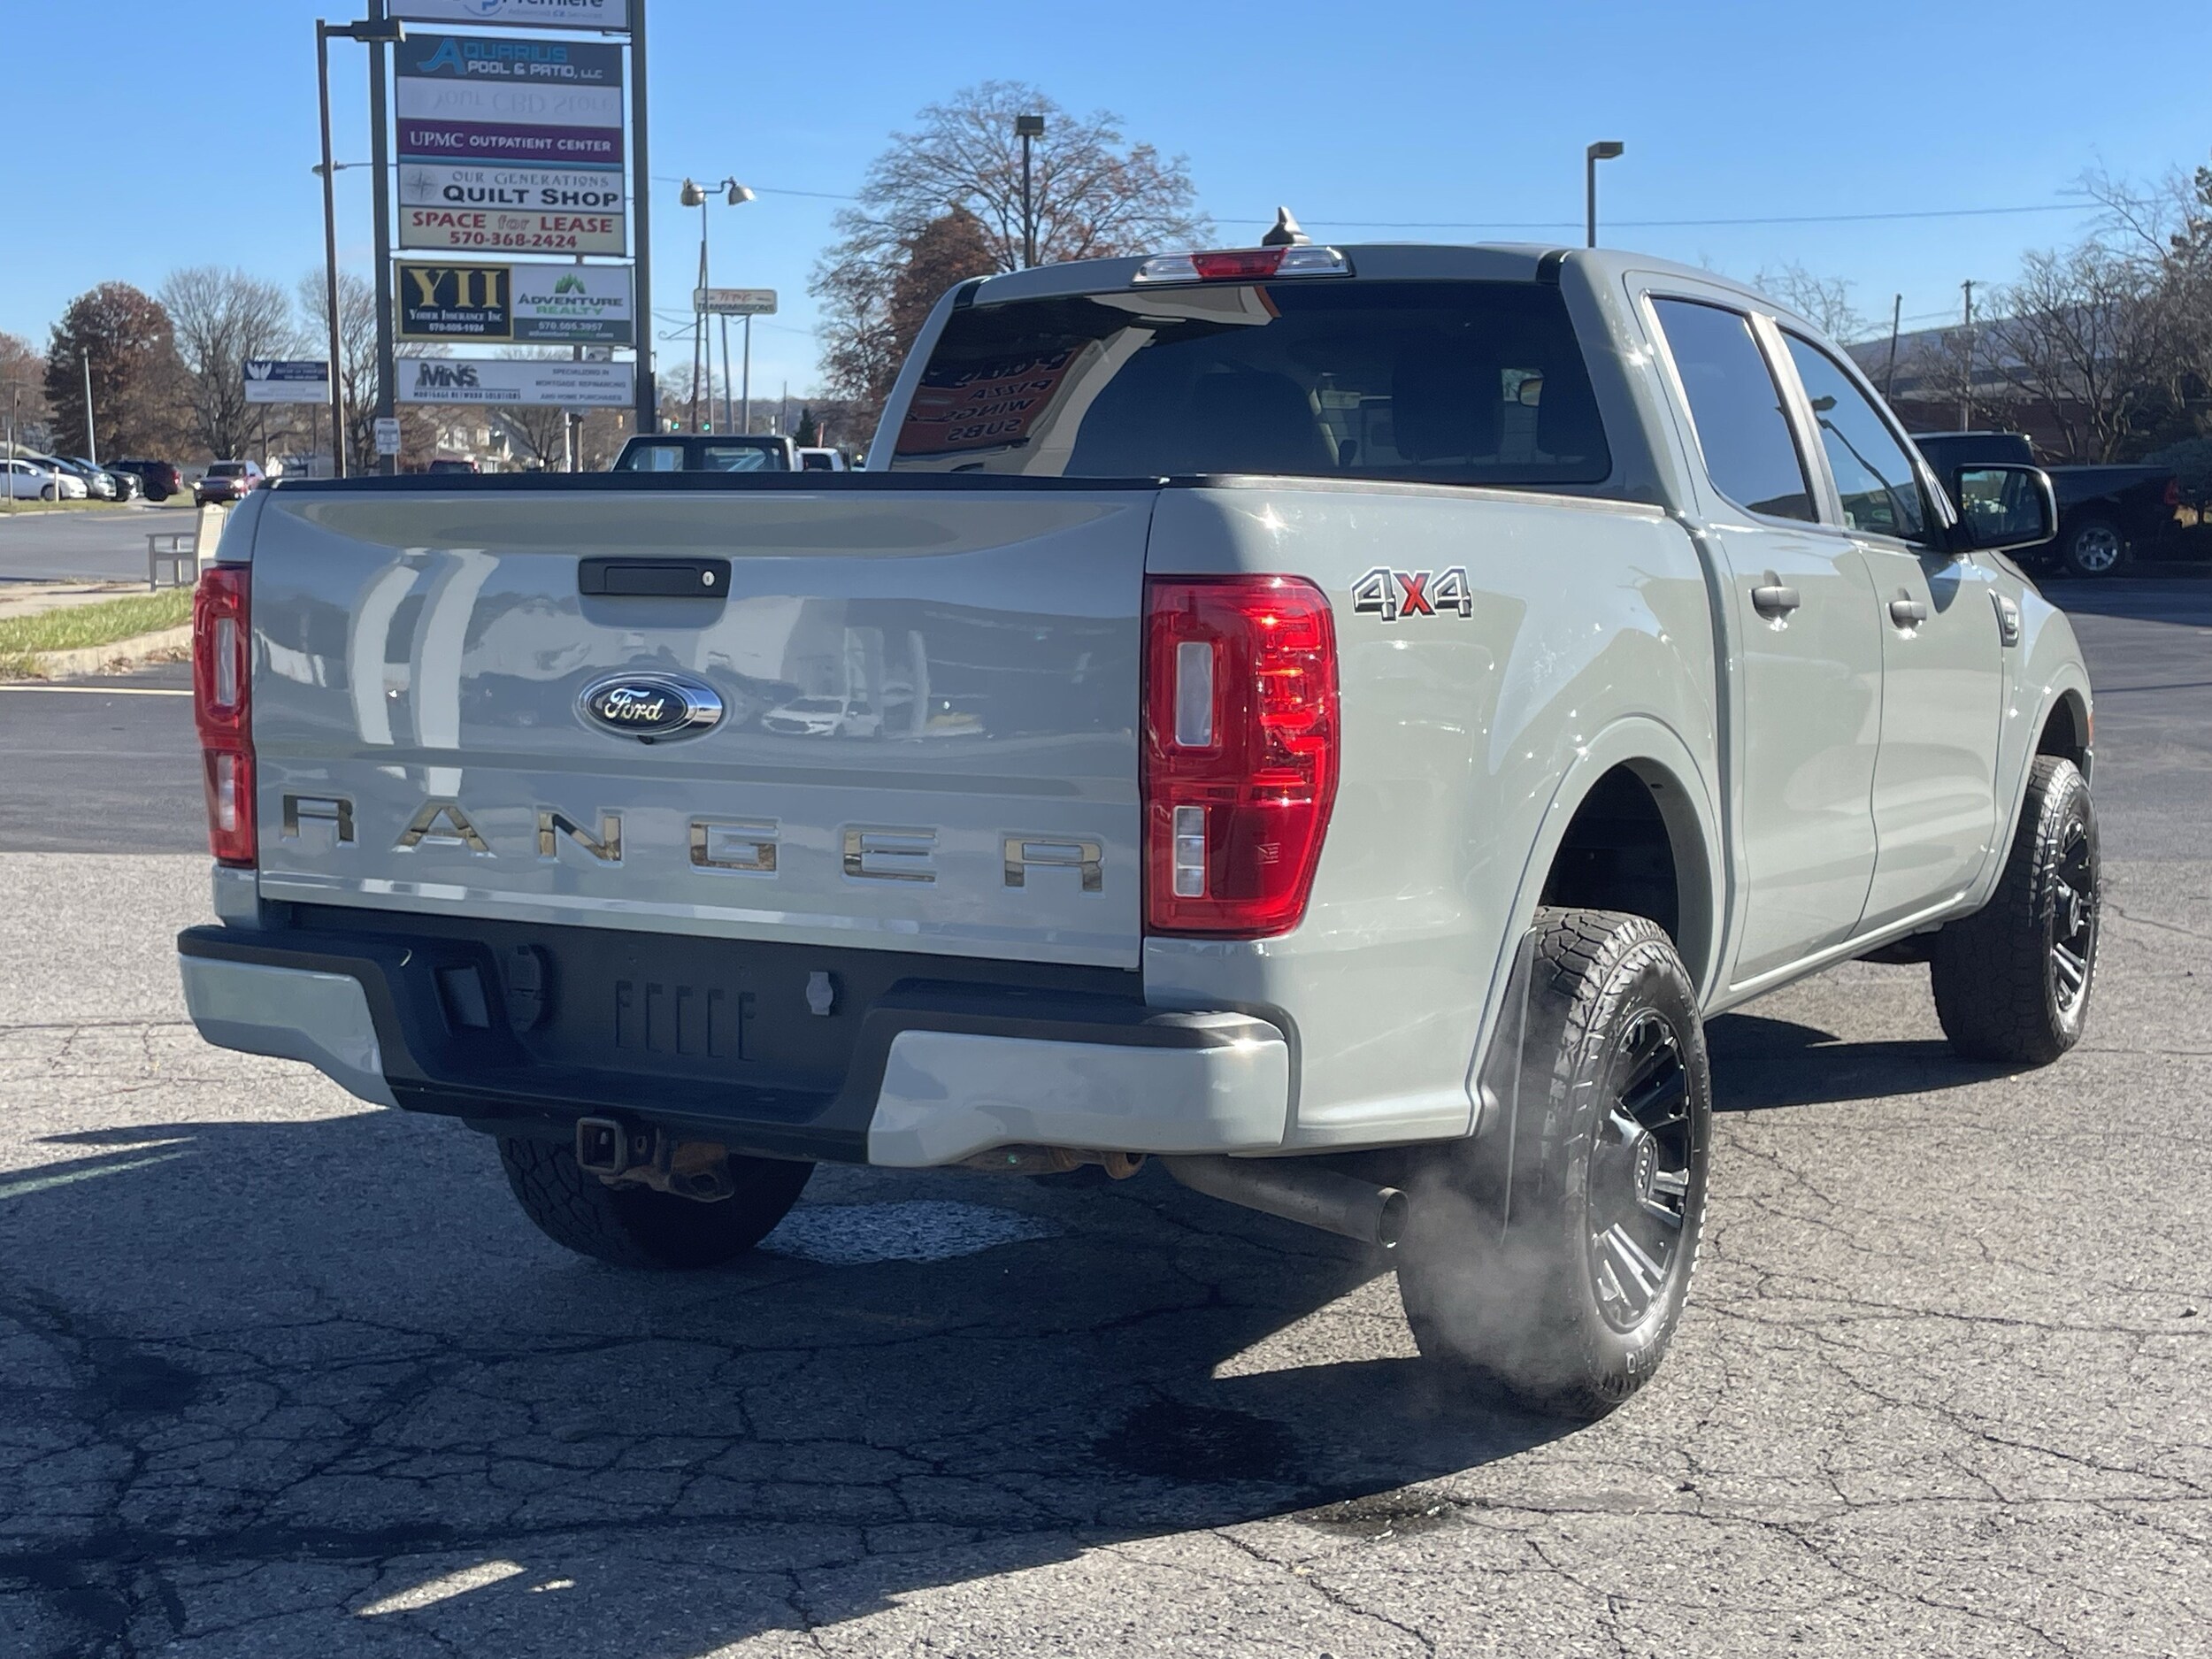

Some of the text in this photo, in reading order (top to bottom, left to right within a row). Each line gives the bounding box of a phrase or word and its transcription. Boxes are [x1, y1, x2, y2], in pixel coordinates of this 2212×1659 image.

[417, 37, 569, 75] AQUARIUS
[467, 63, 603, 80] POOL & PATIO, LLC
[410, 131, 612, 152] UPMC OUTPATIENT CENTER
[452, 171, 610, 188] OUR GENERATIONS
[443, 185, 618, 207] QUILT SHOP
[412, 211, 613, 233] SPACE for LEASE
[449, 231, 578, 249] 570-368-2424
[408, 268, 503, 309] YII
[518, 293, 624, 307] ADVENTURE
[536, 305, 604, 315] REALTY
[604, 687, 665, 721] Ford
[280, 793, 1107, 898] RANGER
